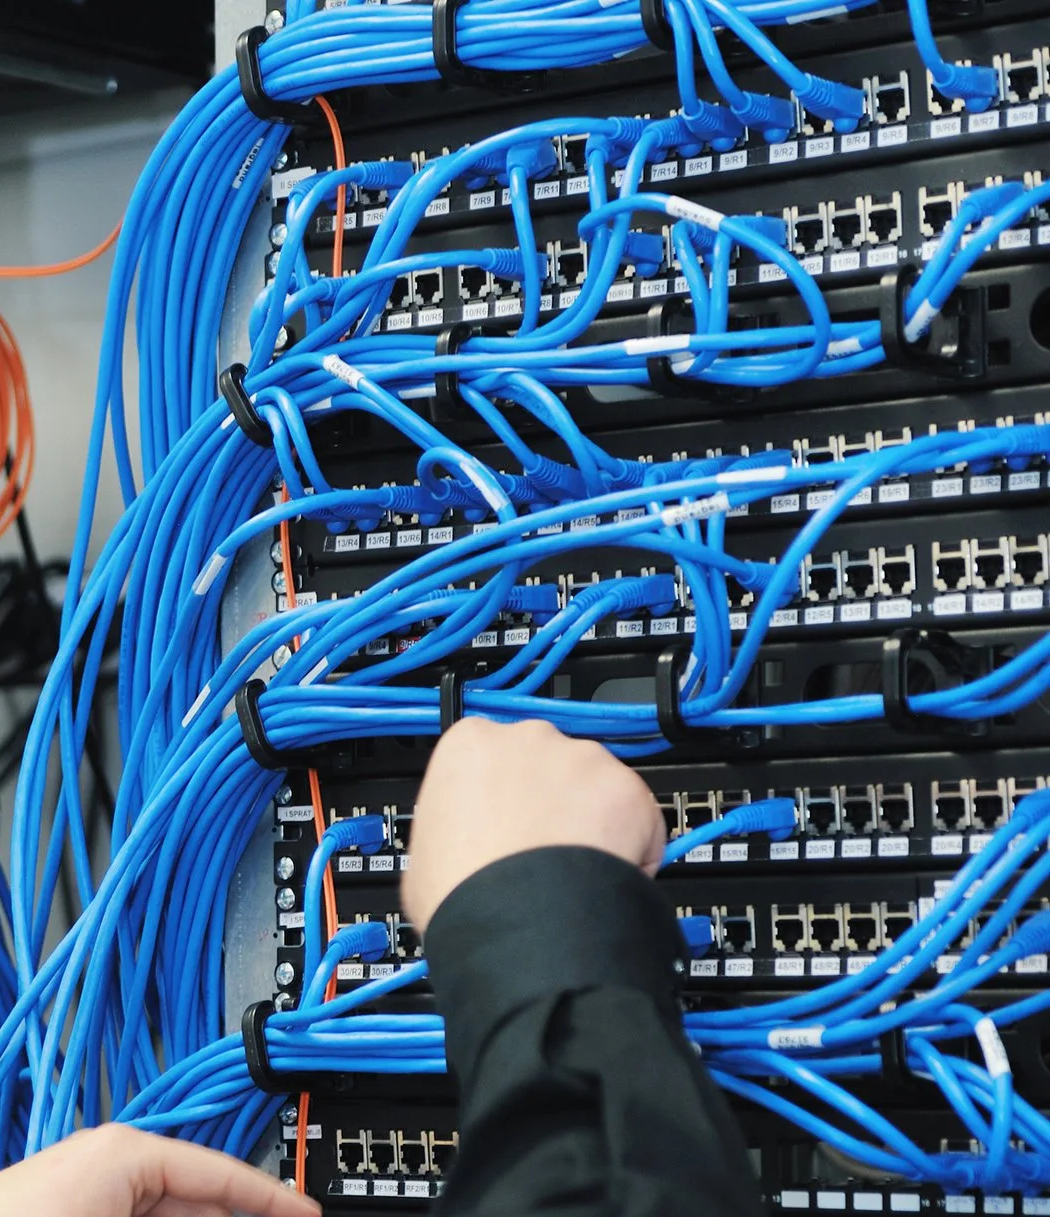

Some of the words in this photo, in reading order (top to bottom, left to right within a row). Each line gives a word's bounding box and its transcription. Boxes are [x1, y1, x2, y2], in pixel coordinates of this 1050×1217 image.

[1012, 110, 1034, 122] 9/R8
[935, 121, 958, 133] 9/R6
[972, 116, 994, 128] 9/R7
[846, 135, 866, 146] 9/R4
[882, 130, 904, 141] 9/R5
[773, 146, 794, 158] 9/R2
[809, 141, 830, 152] 9/R3
[724, 156, 744, 166] 9/R1
[652, 166, 676, 178] 7/R14
[688, 162, 708, 172] 8/R1
[536, 184, 558, 195] 7/R11
[429, 201, 446, 212] 7/R8
[473, 196, 491, 206] 7/R9
[366, 210, 384, 222] 7/R6
[642, 282, 666, 294] 11/R1
[464, 306, 486, 317] 10/R6
[496, 302, 519, 313] 10/R7
[389, 316, 410, 328] 10/R4
[422, 312, 443, 324] 10/R5
[773, 498, 797, 510] 15/R4
[399, 532, 420, 544] 13/R6
[430, 528, 452, 540] 14/R1
[337, 537, 358, 548] 13/R4
[368, 535, 390, 547] 13/R5
[808, 608, 832, 620] 12/R5
[619, 624, 642, 636] 11/R2
[652, 620, 676, 632] 12/R1
[476, 633, 496, 645] 10/R1
[506, 629, 528, 642] 10/R2
[290, 810, 312, 818] SPRAT
[722, 848, 748, 860] 15/R14
[340, 860, 362, 870] 15/R3
[370, 860, 392, 870] 15/R4
[340, 966, 362, 976] 30/R2
[372, 966, 393, 976] 30/R3
[693, 964, 716, 974] 47/R1
[728, 962, 752, 974] 47/R2
[344, 1183, 368, 1193] RF1/R1
[374, 1184, 398, 1194] RF1/R2
[406, 1184, 430, 1194] RF2/R1
